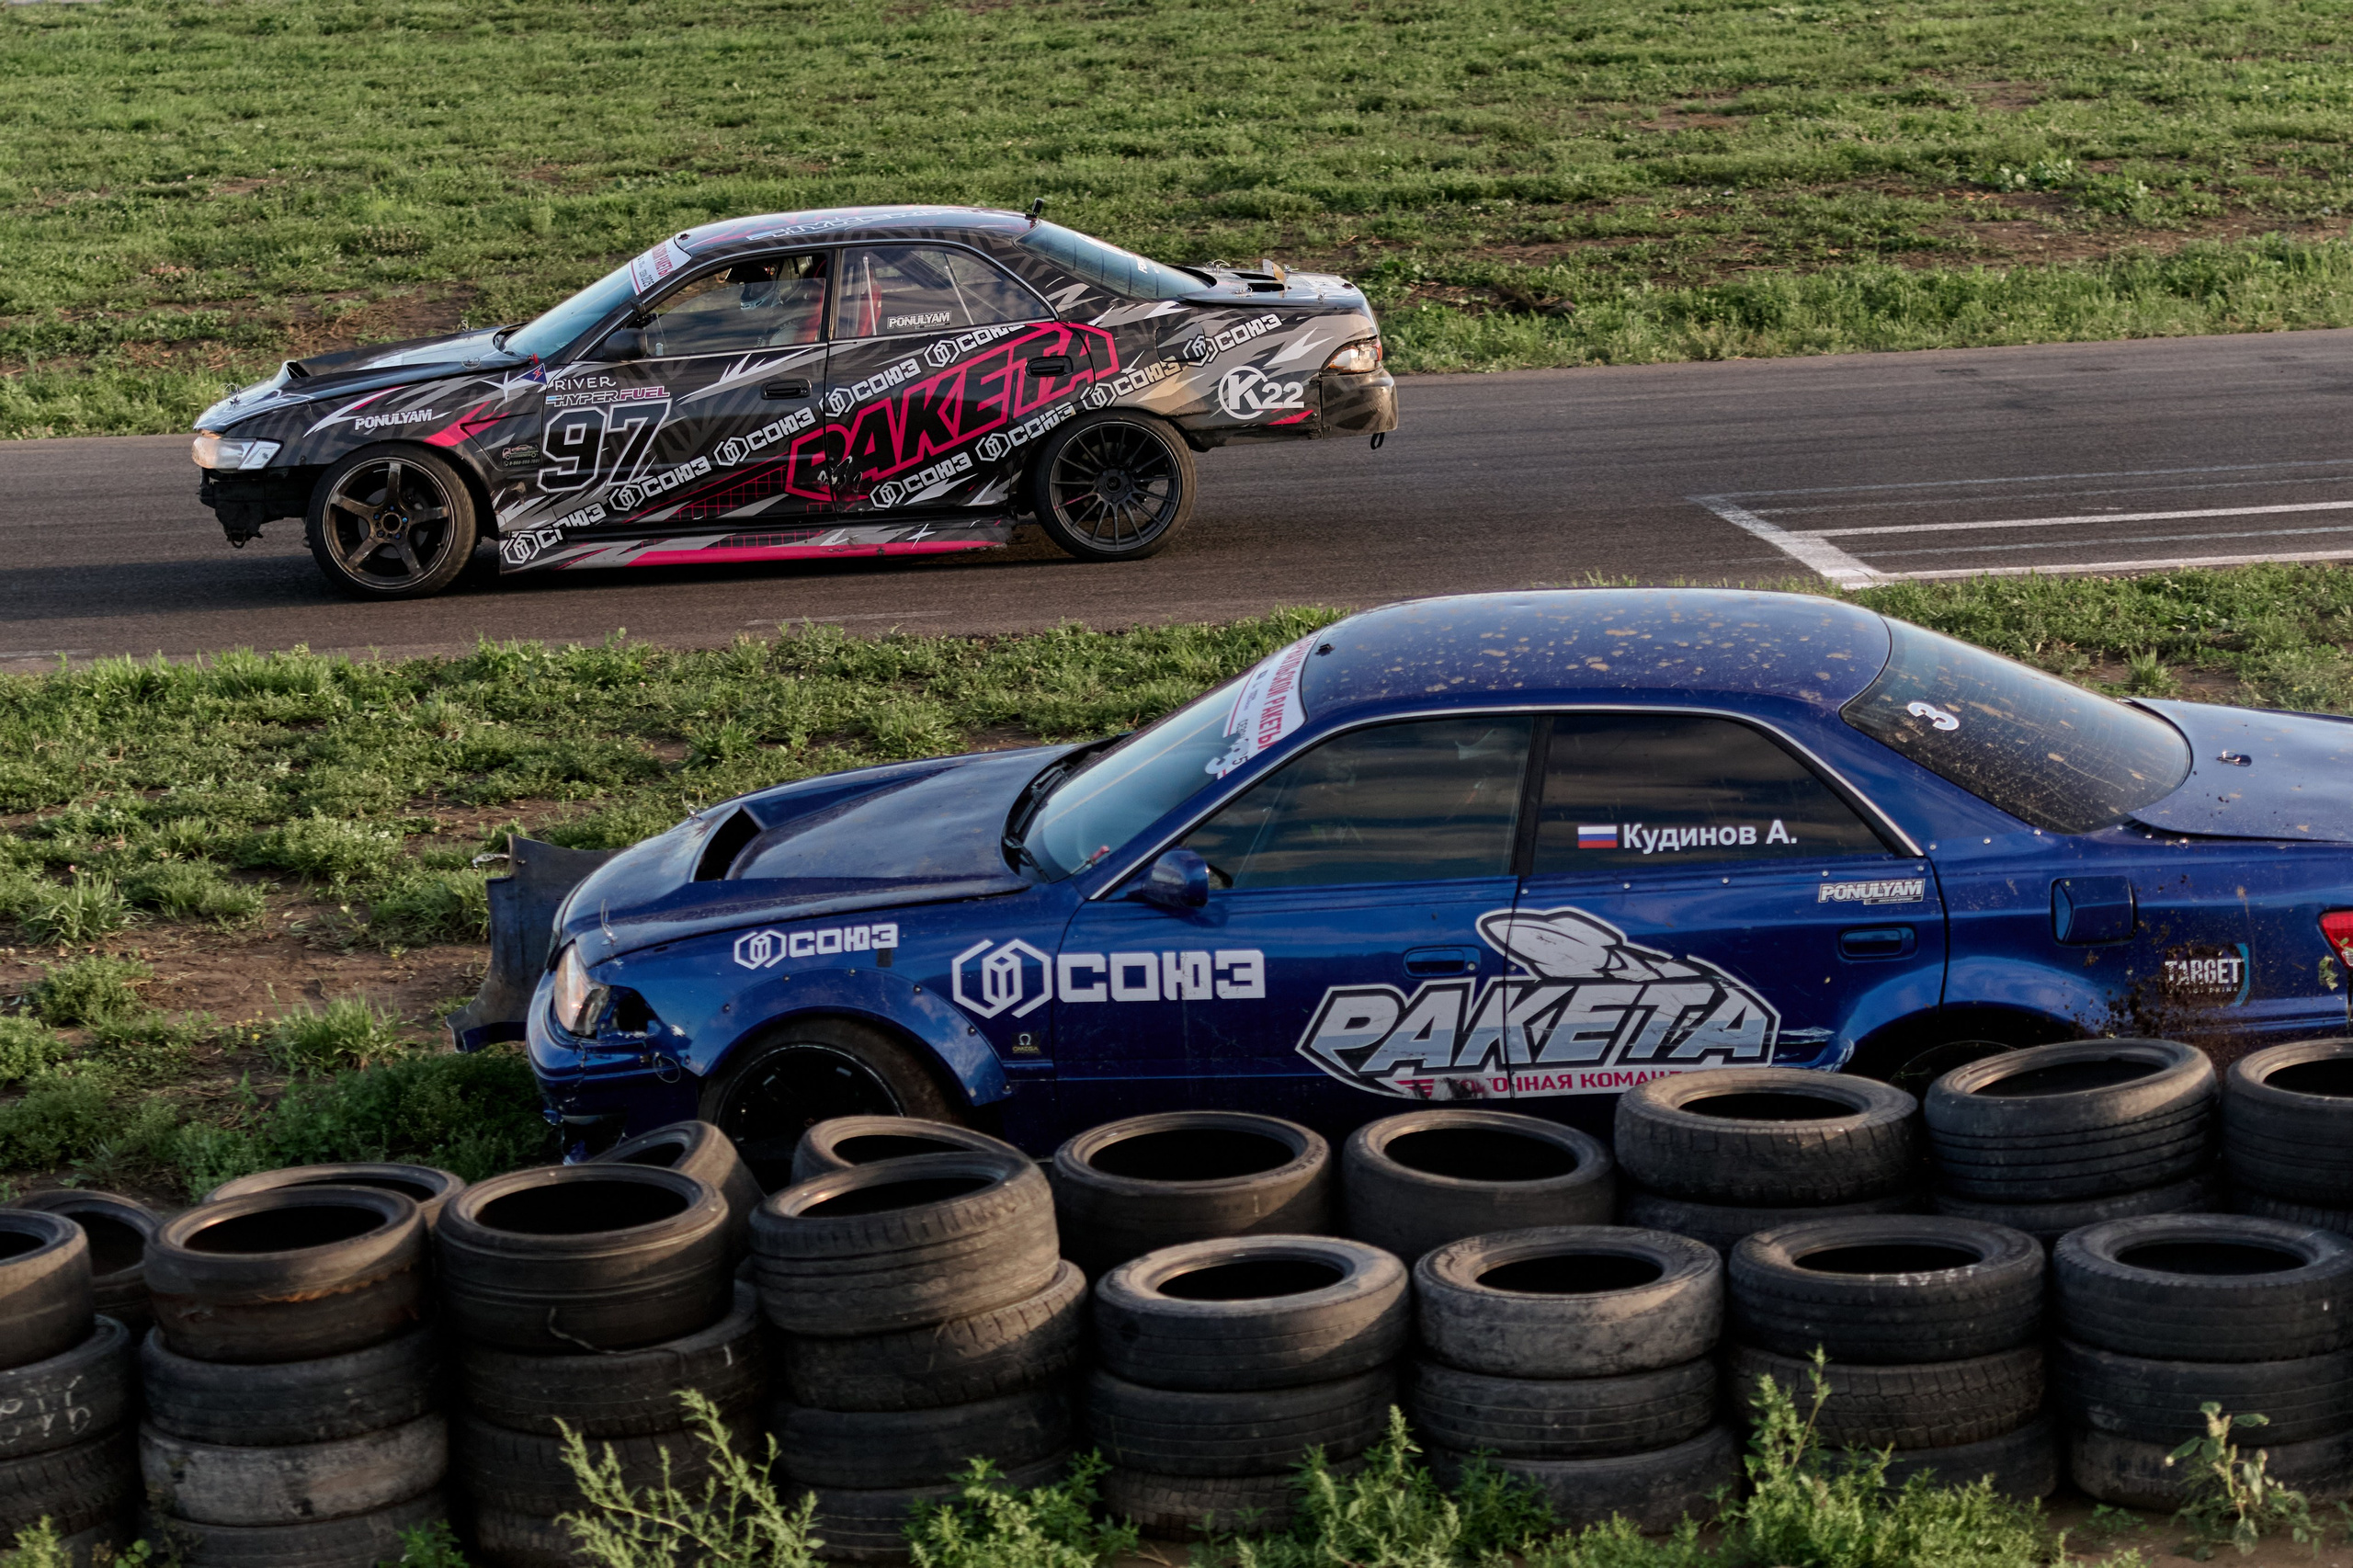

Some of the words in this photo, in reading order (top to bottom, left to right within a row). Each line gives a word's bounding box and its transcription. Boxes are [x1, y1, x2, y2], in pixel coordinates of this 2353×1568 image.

[889, 312, 950, 328] PONULYAM
[1219, 313, 1282, 352] СОЮЗ
[554, 376, 617, 392] RIVER
[854, 358, 921, 401] СОЮЗ
[1115, 356, 1182, 396] СОЮЗ
[1226, 371, 1305, 414] K22
[546, 391, 619, 407] HYPER
[620, 386, 670, 400] FUEL
[784, 322, 1120, 502] РАКЕТА
[354, 408, 433, 431] PONULYAM
[747, 406, 815, 450] СОЮЗ
[1011, 402, 1076, 448] СОЮЗ
[537, 398, 674, 494] 97
[643, 455, 711, 497] СОЮЗ
[906, 451, 972, 493] СОЮЗ
[1907, 702, 1960, 731] 3
[1623, 824, 1756, 855] Кудинов
[1766, 821, 1798, 845] А.
[1820, 880, 1924, 902] PONULYAM
[789, 924, 898, 958] СОЮЗ
[1057, 949, 1266, 1002] СОЮЗ
[2165, 958, 2245, 985] TARGET
[1307, 983, 1768, 1074] РАКЕТА
